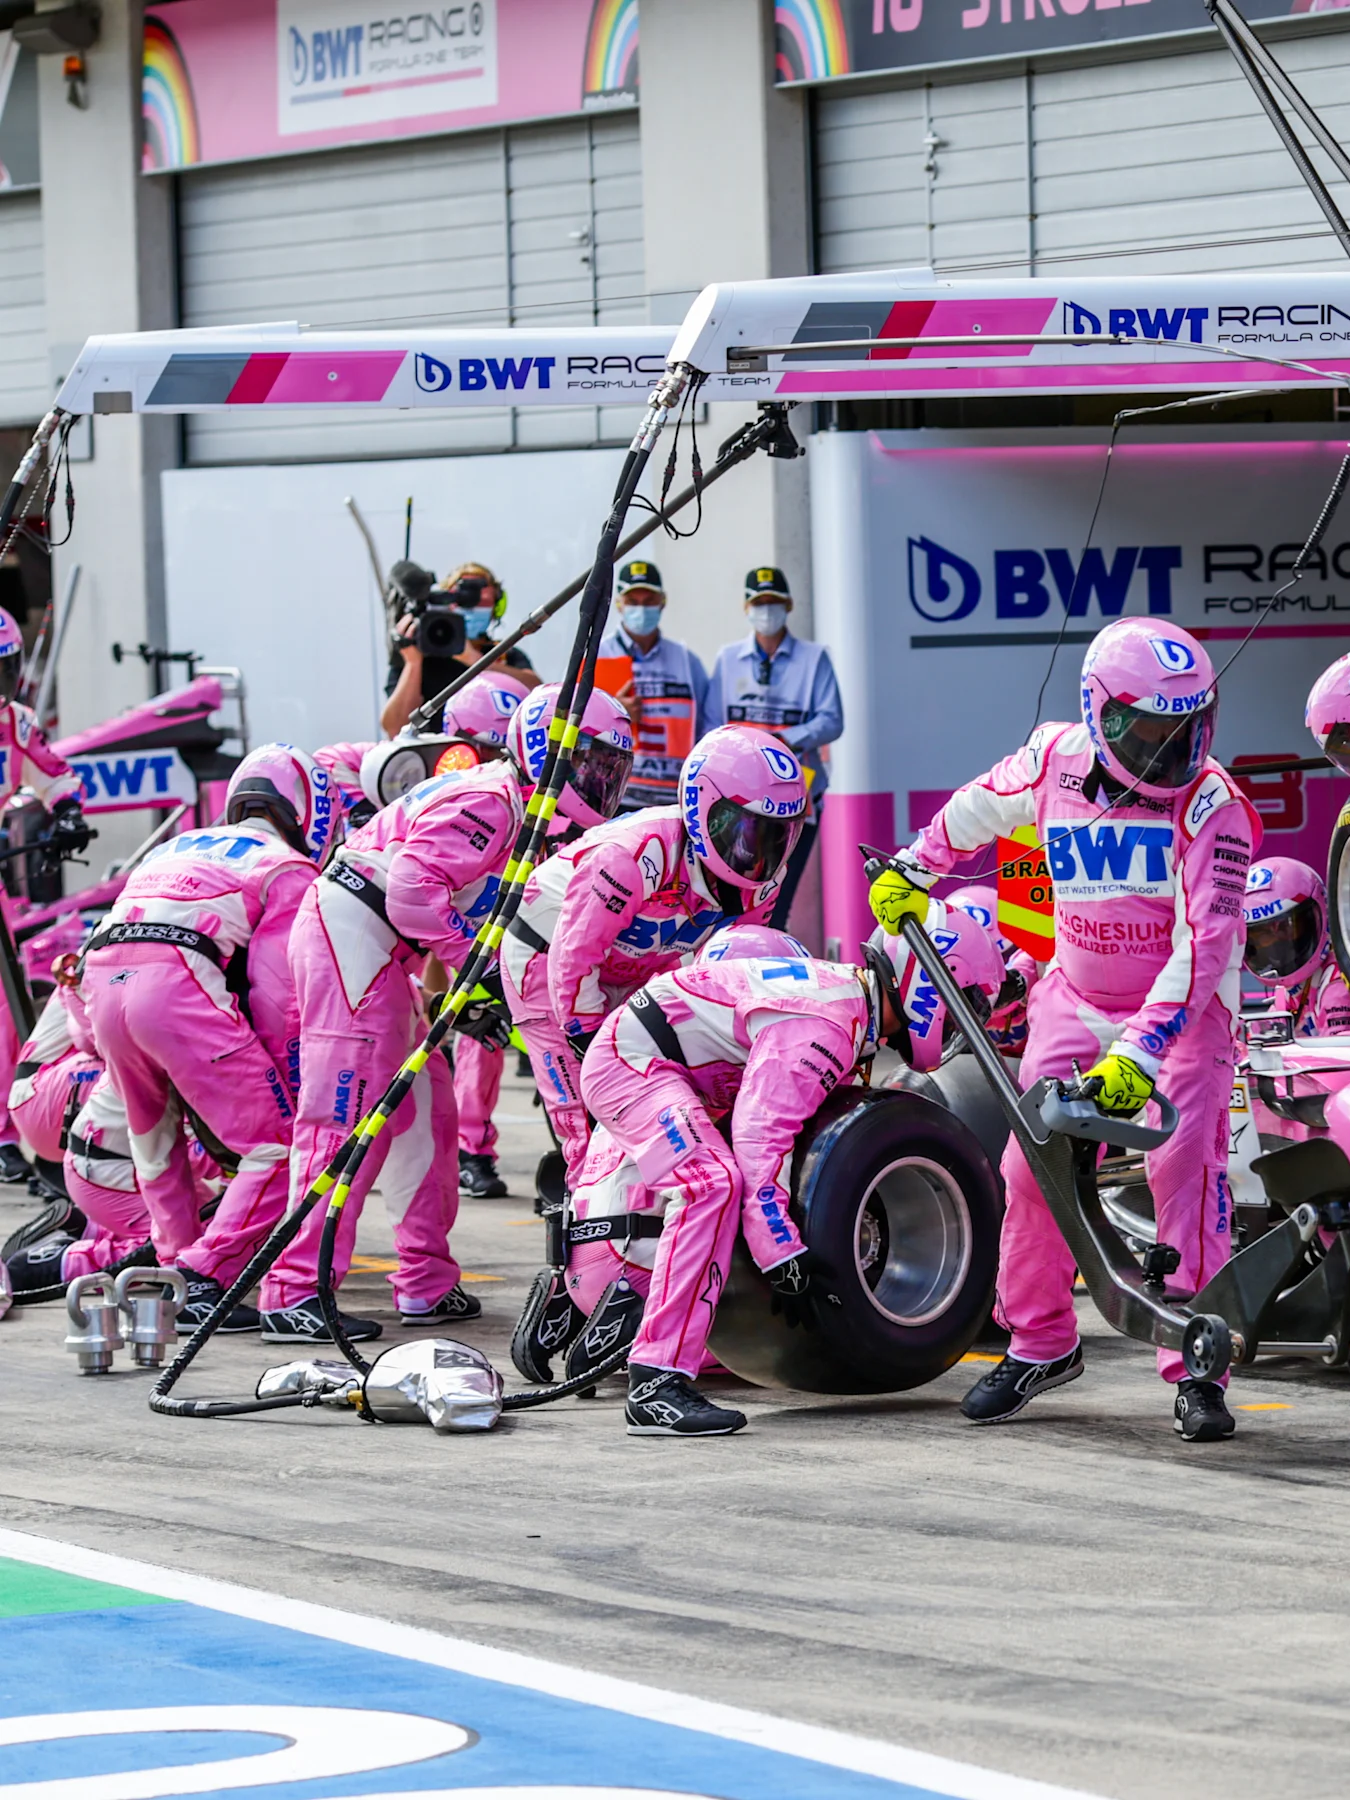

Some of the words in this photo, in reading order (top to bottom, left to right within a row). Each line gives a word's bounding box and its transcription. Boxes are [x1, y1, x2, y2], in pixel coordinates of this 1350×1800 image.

[312, 25, 363, 81] BWT
[369, 8, 464, 49] RACING
[369, 53, 421, 73] FORMULA
[453, 44, 485, 62] TEAM
[1109, 308, 1209, 344] BWT
[1218, 332, 1313, 344] FORMULA
[459, 356, 556, 392] BWT
[568, 354, 666, 375] RAC
[718, 376, 771, 387] TEAM
[994, 544, 1182, 620] BWT
[1171, 690, 1208, 713] BWT
[525, 727, 549, 778] BW
[73, 756, 175, 800] BWT
[1061, 774, 1084, 793] JC
[777, 797, 804, 816] BWT
[1136, 796, 1168, 814] Claro
[308, 794, 331, 864] BWT
[450, 822, 472, 838] canada
[460, 808, 497, 835] BOMBARDIER
[685, 786, 709, 859] BWT
[1047, 826, 1174, 883] BWT
[1215, 833, 1250, 849] Infinitum
[1002, 861, 1050, 879] BRA
[1213, 847, 1250, 866] PIRELLI
[599, 868, 633, 898] BOMBARDIER
[1071, 885, 1097, 895] WATER
[1098, 884, 1159, 895] TECHNOLOGY
[1208, 902, 1240, 919] MOND
[1218, 896, 1241, 908] AQUA
[1251, 899, 1283, 920] BWT
[1058, 902, 1171, 942] MAGNESIUM
[1123, 940, 1173, 956] WATER
[1155, 1006, 1188, 1041] BWT
[800, 1057, 824, 1078] canada
[810, 1041, 845, 1074] BOMBARDIER
[77, 1069, 100, 1083] BWT
[547, 1067, 569, 1104] BWT
[556, 1054, 578, 1101] Watson
[271, 1082, 293, 1119] BWT
[333, 1086, 351, 1125] BWT
[762, 1198, 793, 1245] BWT
